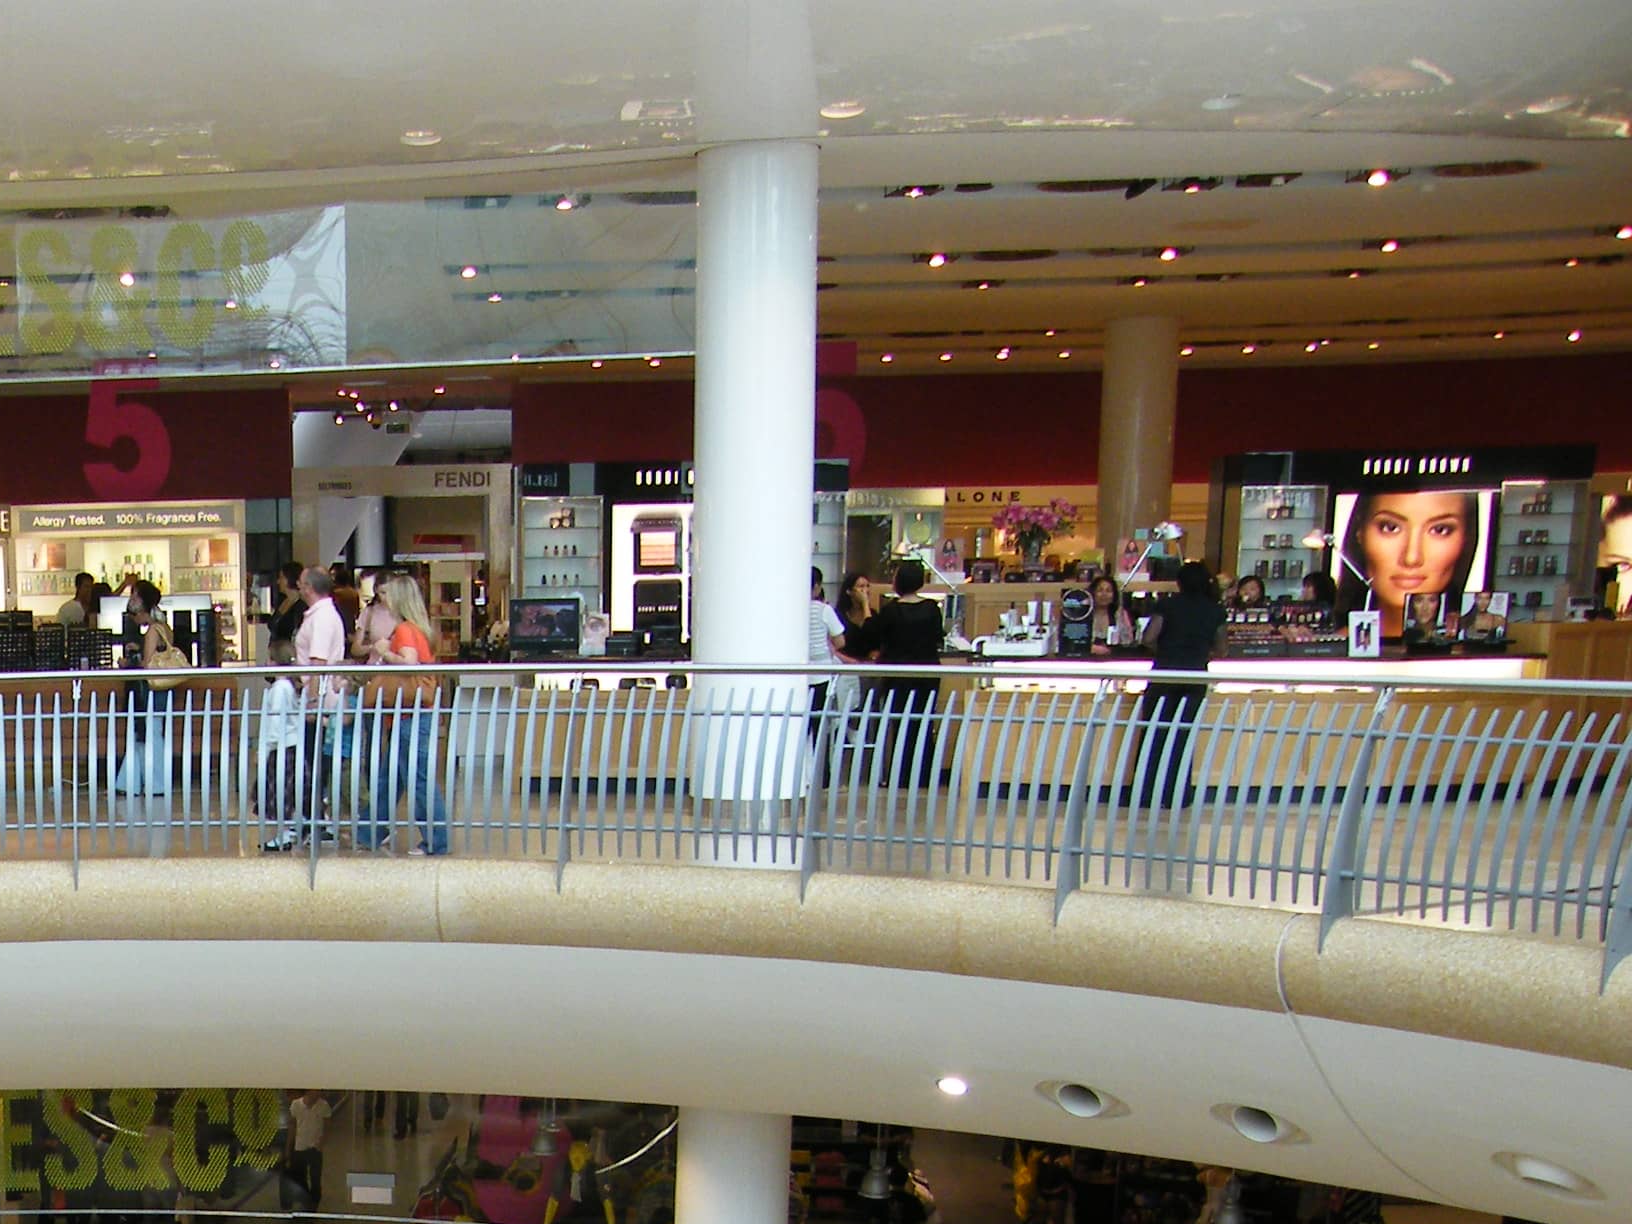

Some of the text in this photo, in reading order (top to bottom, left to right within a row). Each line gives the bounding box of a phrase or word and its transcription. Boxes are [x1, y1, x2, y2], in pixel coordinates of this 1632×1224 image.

[81, 360, 172, 501] 5
[434, 471, 491, 488] FENDI
[945, 490, 1021, 503] LONE
[32, 515, 66, 528] Allergy
[69, 514, 106, 526] Tested.
[116, 513, 143, 525] 100%
[146, 512, 196, 526] Fragrance
